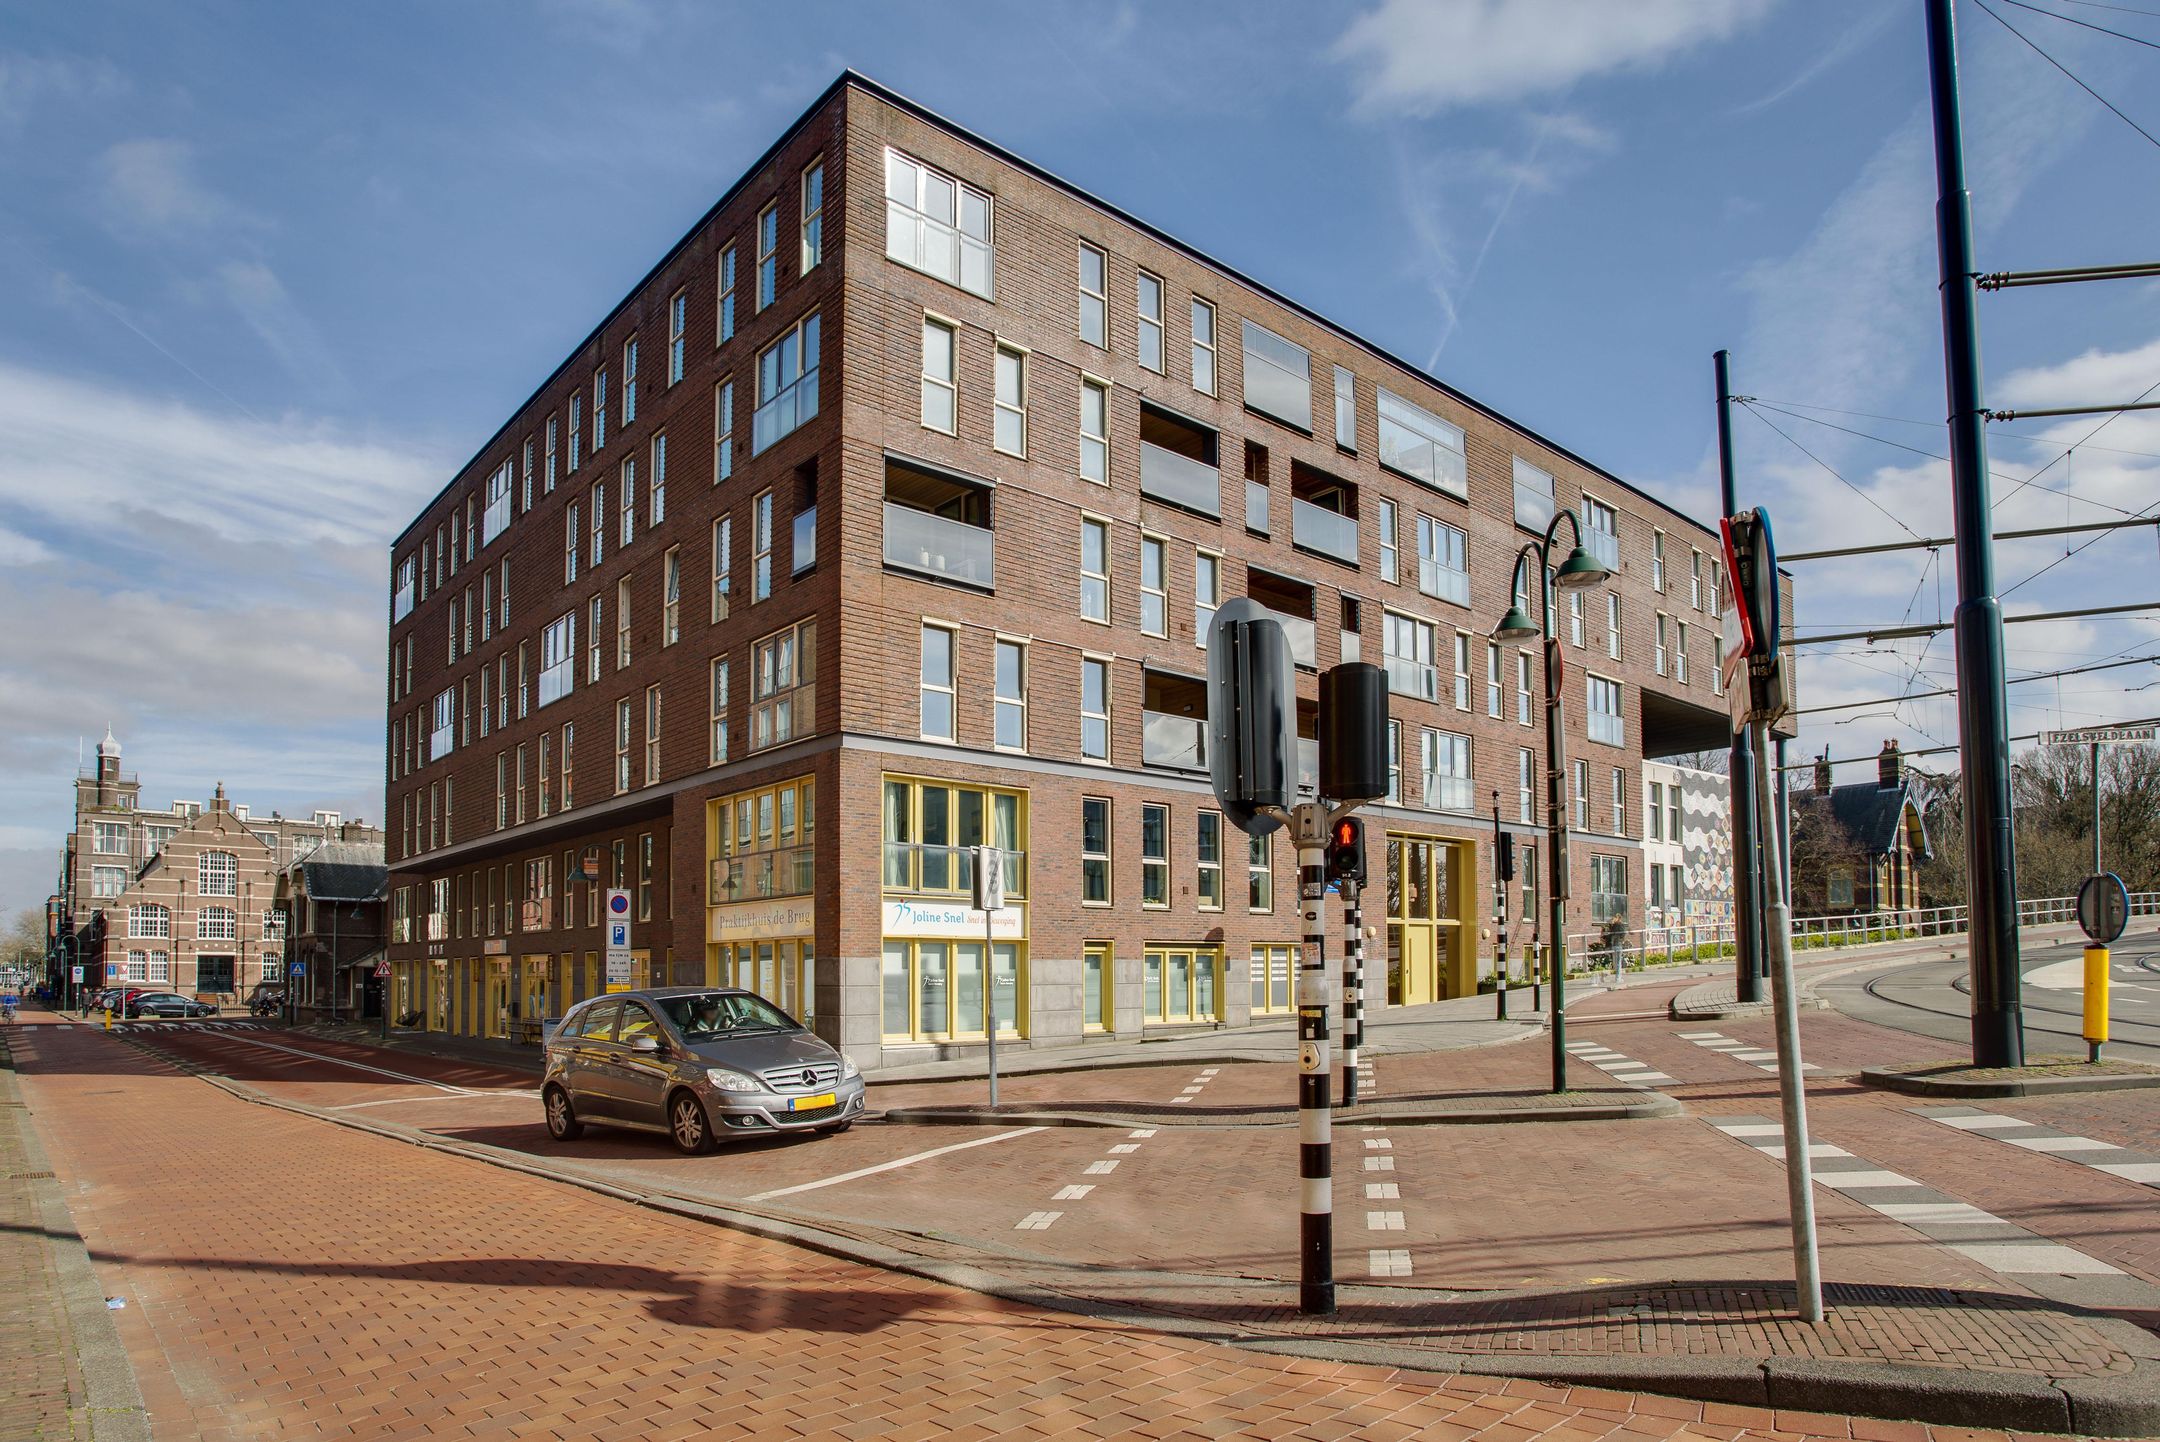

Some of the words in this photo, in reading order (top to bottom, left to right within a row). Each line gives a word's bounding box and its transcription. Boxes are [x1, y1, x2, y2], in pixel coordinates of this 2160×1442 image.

[2052, 730, 2150, 743] EZELSVELDLAAN
[719, 912, 772, 929] Praktijkhuis
[773, 910, 785, 925] de
[787, 909, 811, 927] Brug
[912, 910, 941, 924] Joline
[944, 911, 965, 924] Snel
[615, 928, 623, 938] P
